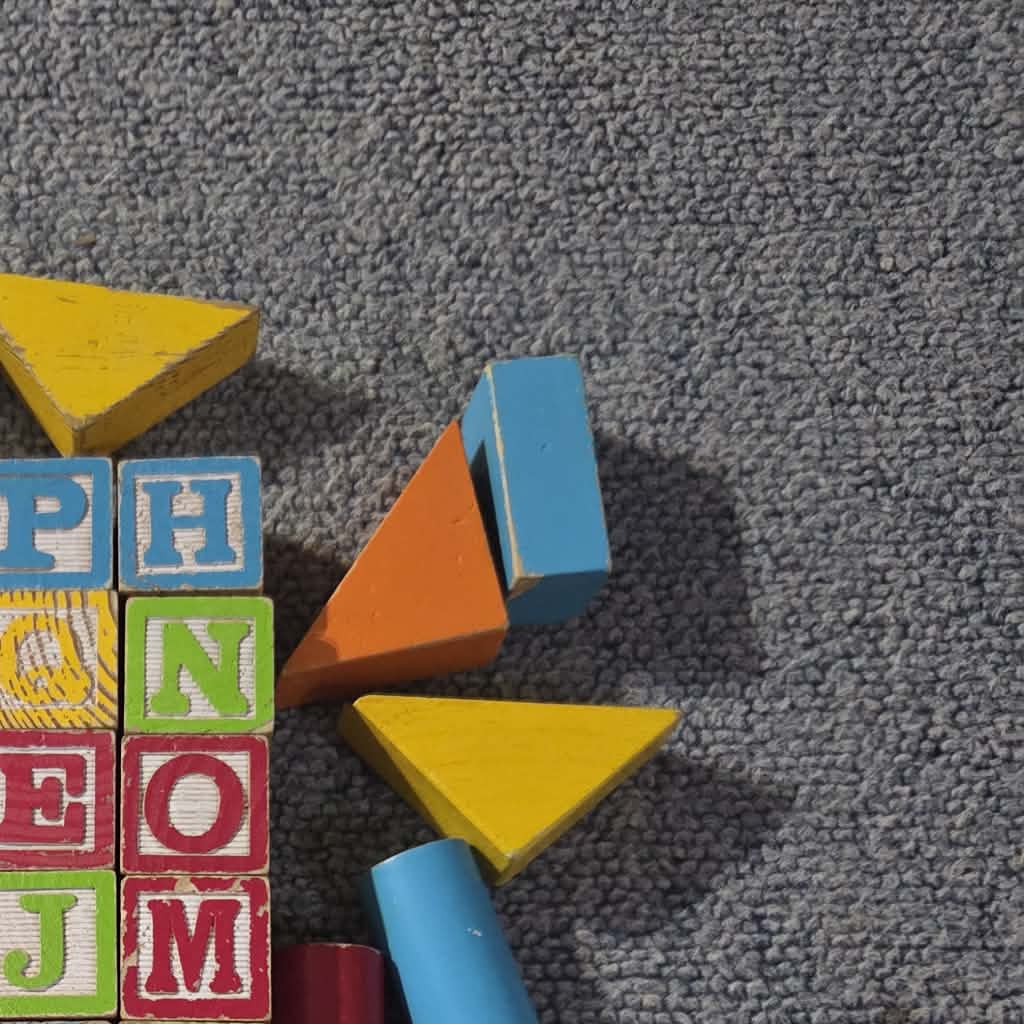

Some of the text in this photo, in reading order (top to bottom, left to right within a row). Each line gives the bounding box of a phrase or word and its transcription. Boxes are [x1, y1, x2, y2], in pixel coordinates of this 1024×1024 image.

[143, 479, 236, 567] H
[149, 621, 250, 716] N
[144, 753, 244, 853] O
[4, 893, 77, 989] J
[145, 899, 242, 993] M
